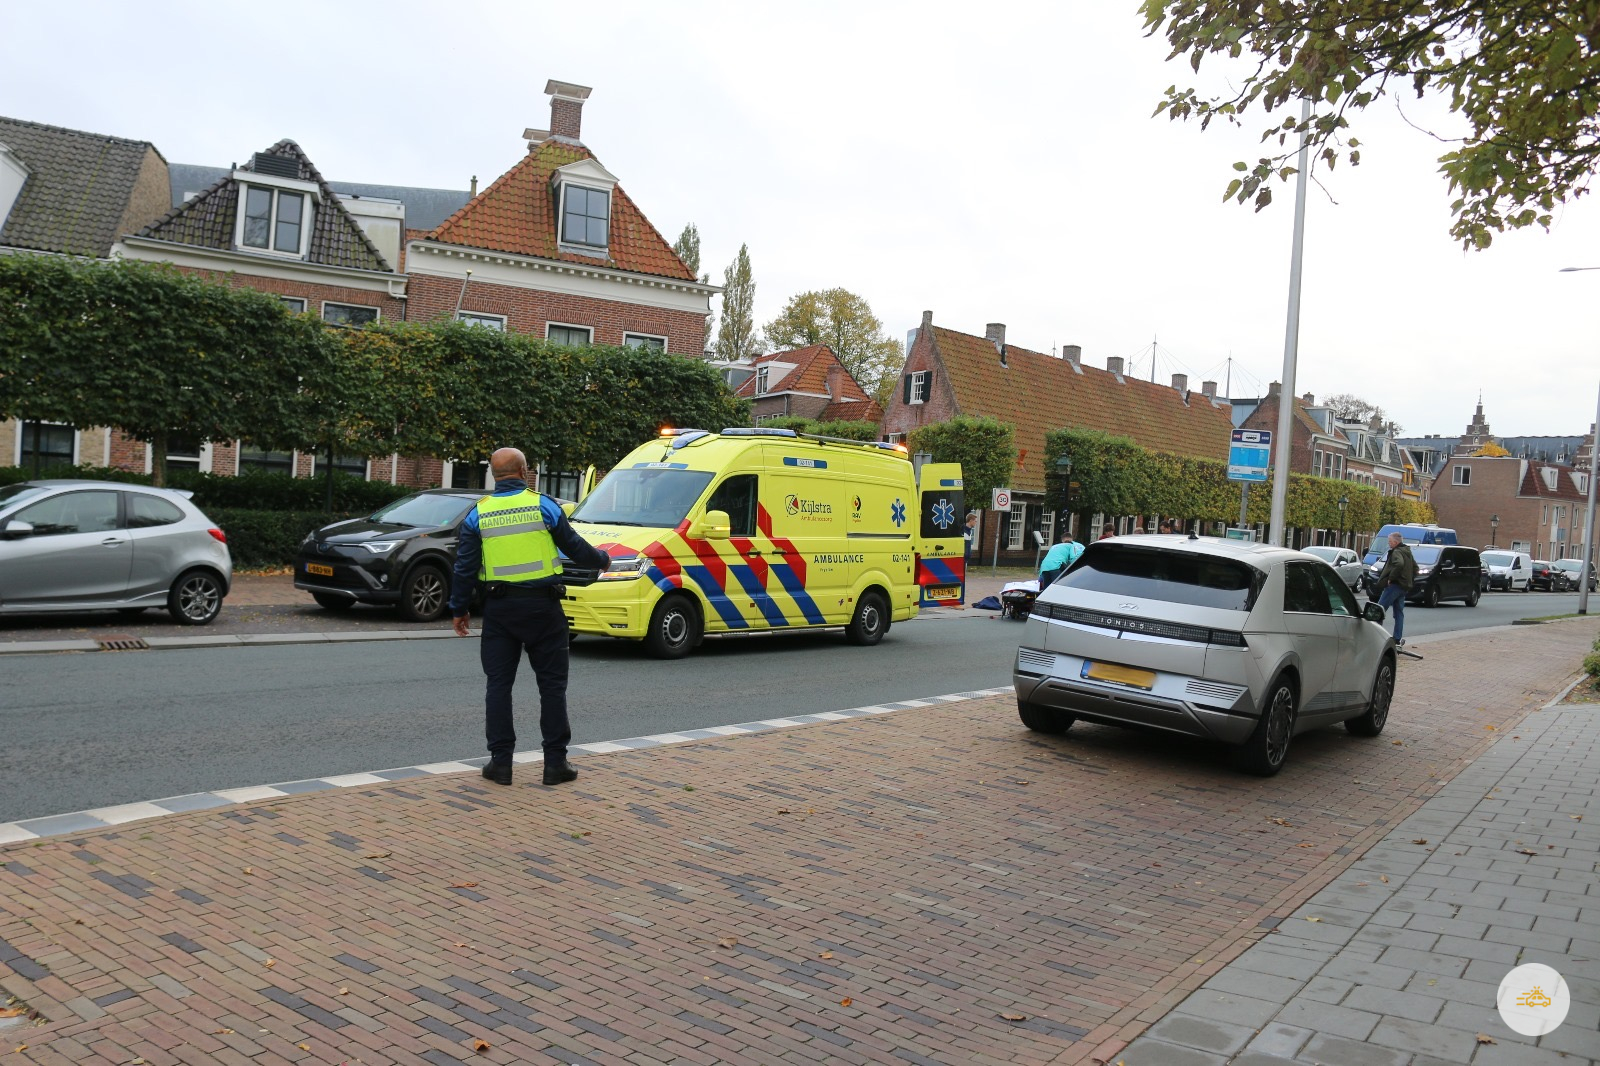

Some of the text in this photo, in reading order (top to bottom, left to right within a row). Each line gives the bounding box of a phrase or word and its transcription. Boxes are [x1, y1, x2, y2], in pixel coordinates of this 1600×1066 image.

[800, 499, 832, 516] Kijlstra
[481, 512, 539, 528] HANDHAVING
[813, 554, 864, 564] AMBULANCE
[892, 554, 911, 563] 02-141
